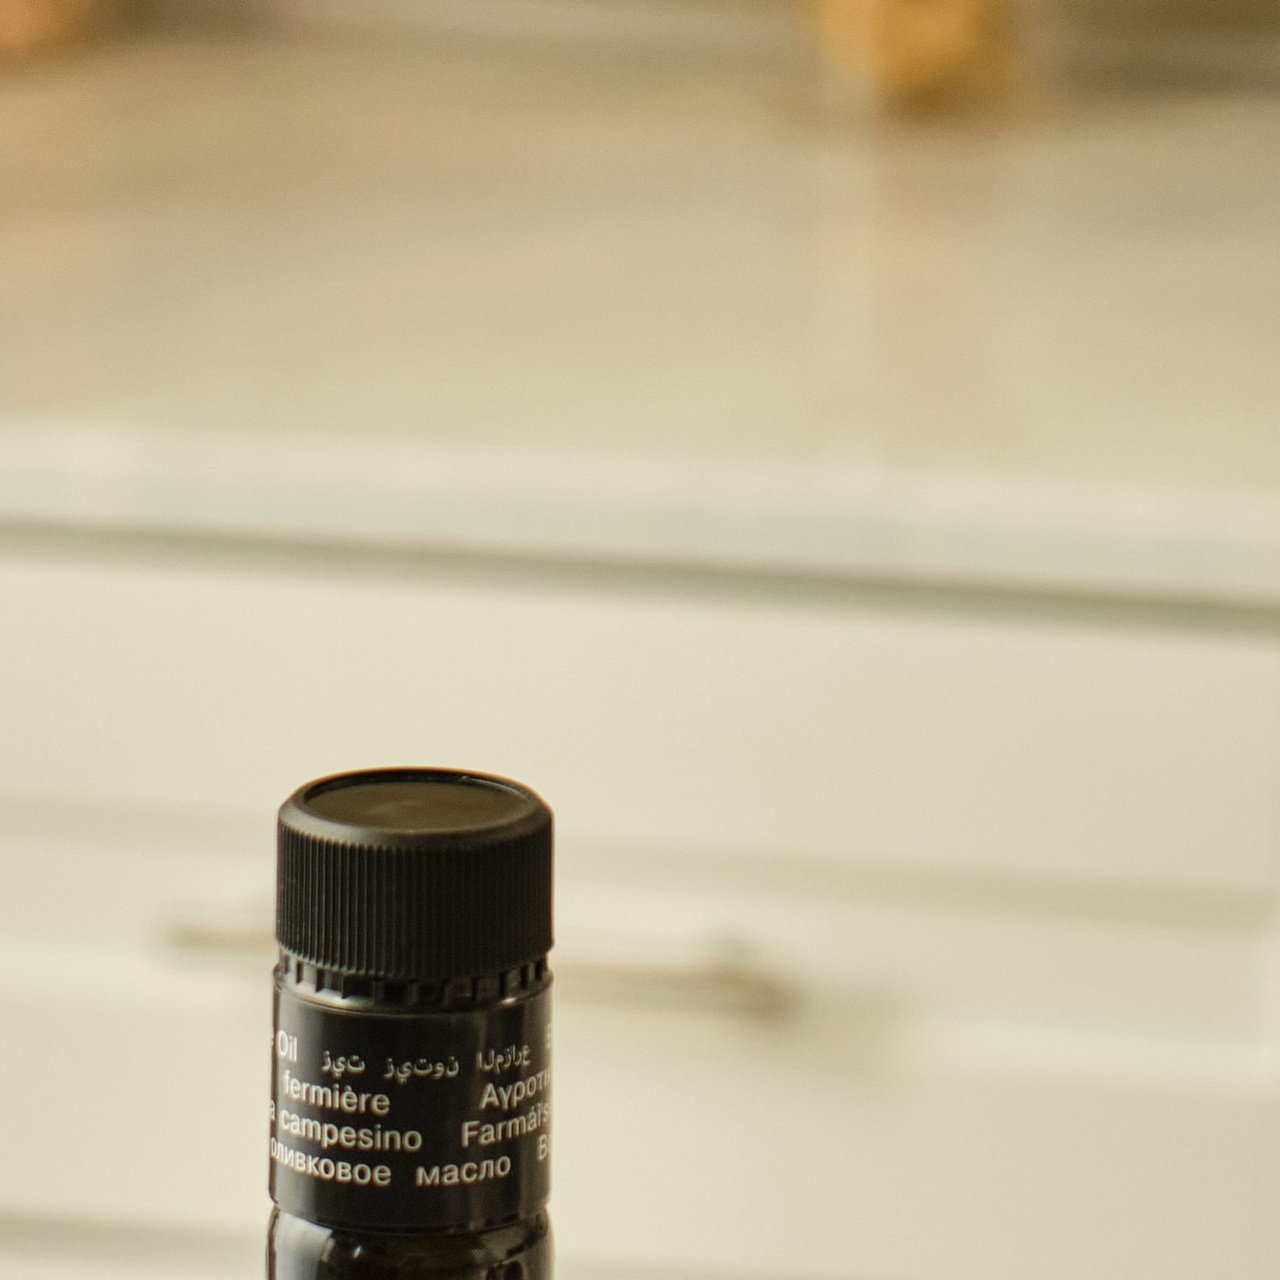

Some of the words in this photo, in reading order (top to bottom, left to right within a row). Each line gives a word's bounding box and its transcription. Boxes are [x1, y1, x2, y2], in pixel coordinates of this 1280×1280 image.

[283, 1069, 391, 1116] fermière
[280, 1108, 423, 1153] campesino
[271, 1137, 392, 1188] оливковое
[415, 1154, 513, 1187] масло
